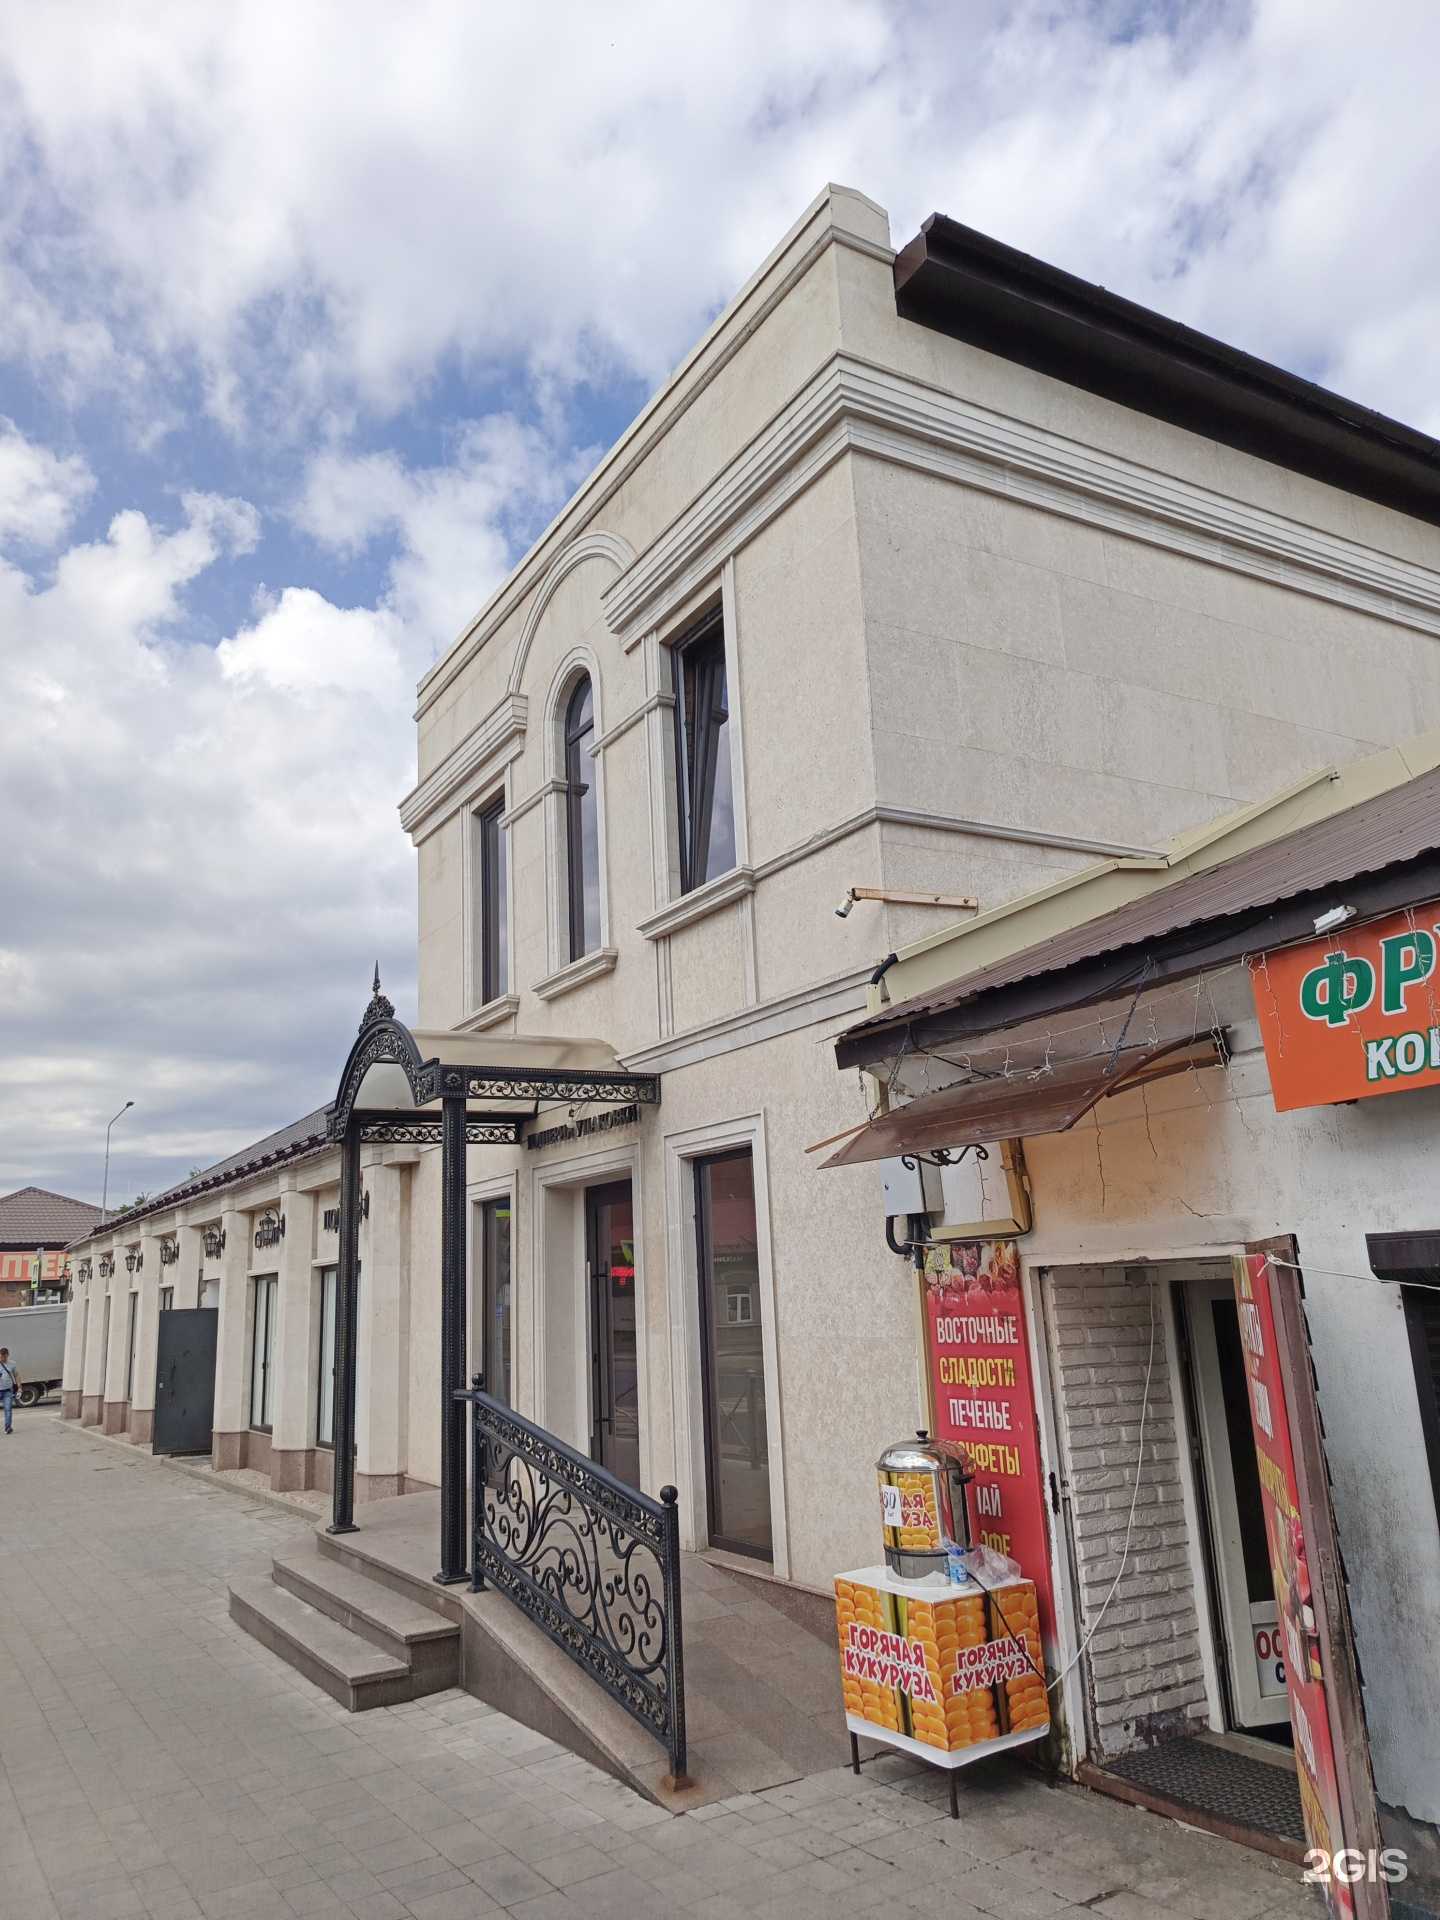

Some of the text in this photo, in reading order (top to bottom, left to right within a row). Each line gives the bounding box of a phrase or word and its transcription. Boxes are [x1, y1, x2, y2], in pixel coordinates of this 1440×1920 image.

[1301, 924, 1440, 1028] ФР
[936, 1316, 1018, 1344] ВОСТОЧНЫЕ
[940, 1357, 1015, 1387] СЛАДОСТИ
[949, 1399, 1012, 1431] ПЕЧЕНЬЕ
[849, 1623, 926, 1670] ГОРЯЧАЯ
[956, 1636, 1027, 1671] ГОРЯЧАЯ
[845, 1650, 936, 1702] КУКУРУЗА
[952, 1658, 1035, 1694] КУКУРУЗА
